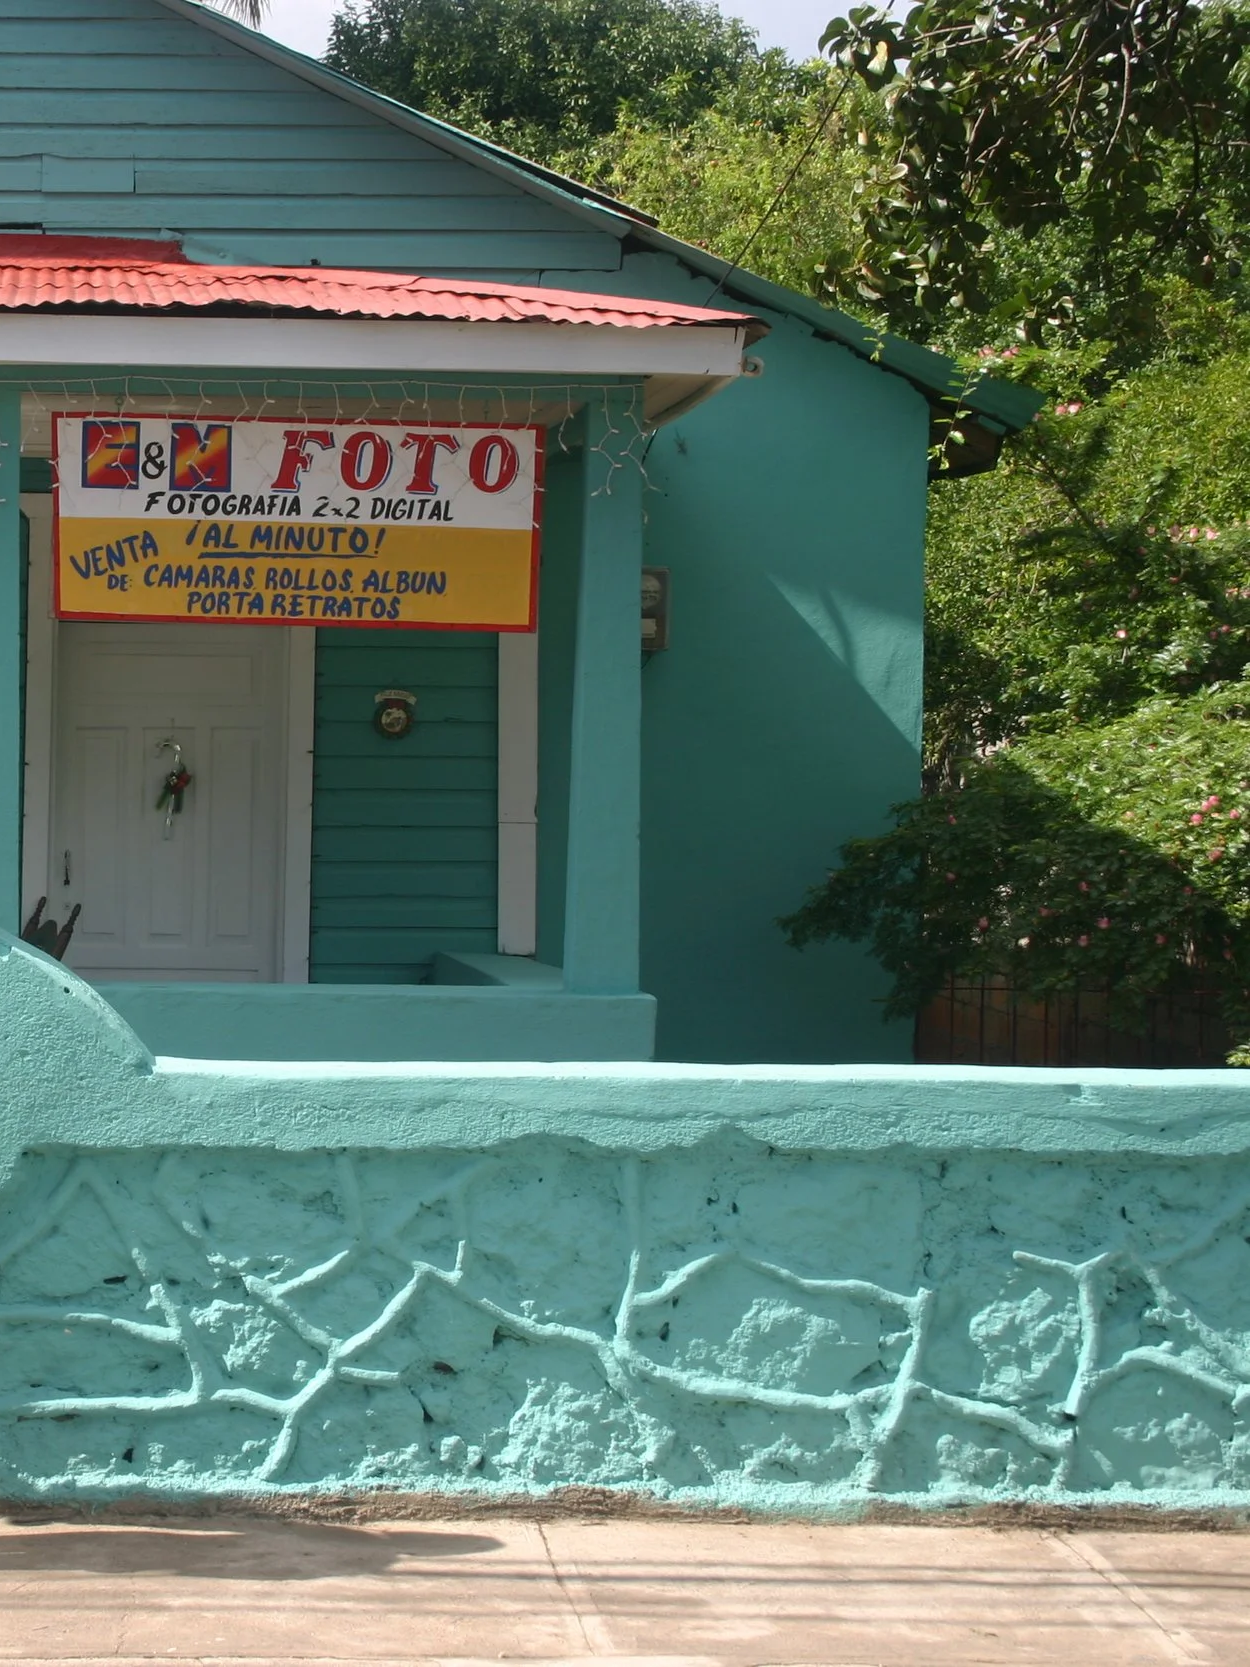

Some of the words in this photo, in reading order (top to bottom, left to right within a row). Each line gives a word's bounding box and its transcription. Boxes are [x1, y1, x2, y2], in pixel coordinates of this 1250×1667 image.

[82, 421, 232, 492] E&M
[270, 430, 519, 495] FOTO
[144, 491, 301, 516] FOTOGRAFIA
[312, 496, 360, 519] 2x2
[371, 498, 454, 521] DIGITAL
[69, 530, 159, 579] VENTA
[250, 525, 386, 554] MINUTO!
[187, 591, 264, 616] PORTA
[271, 594, 401, 619] RETRATOS
